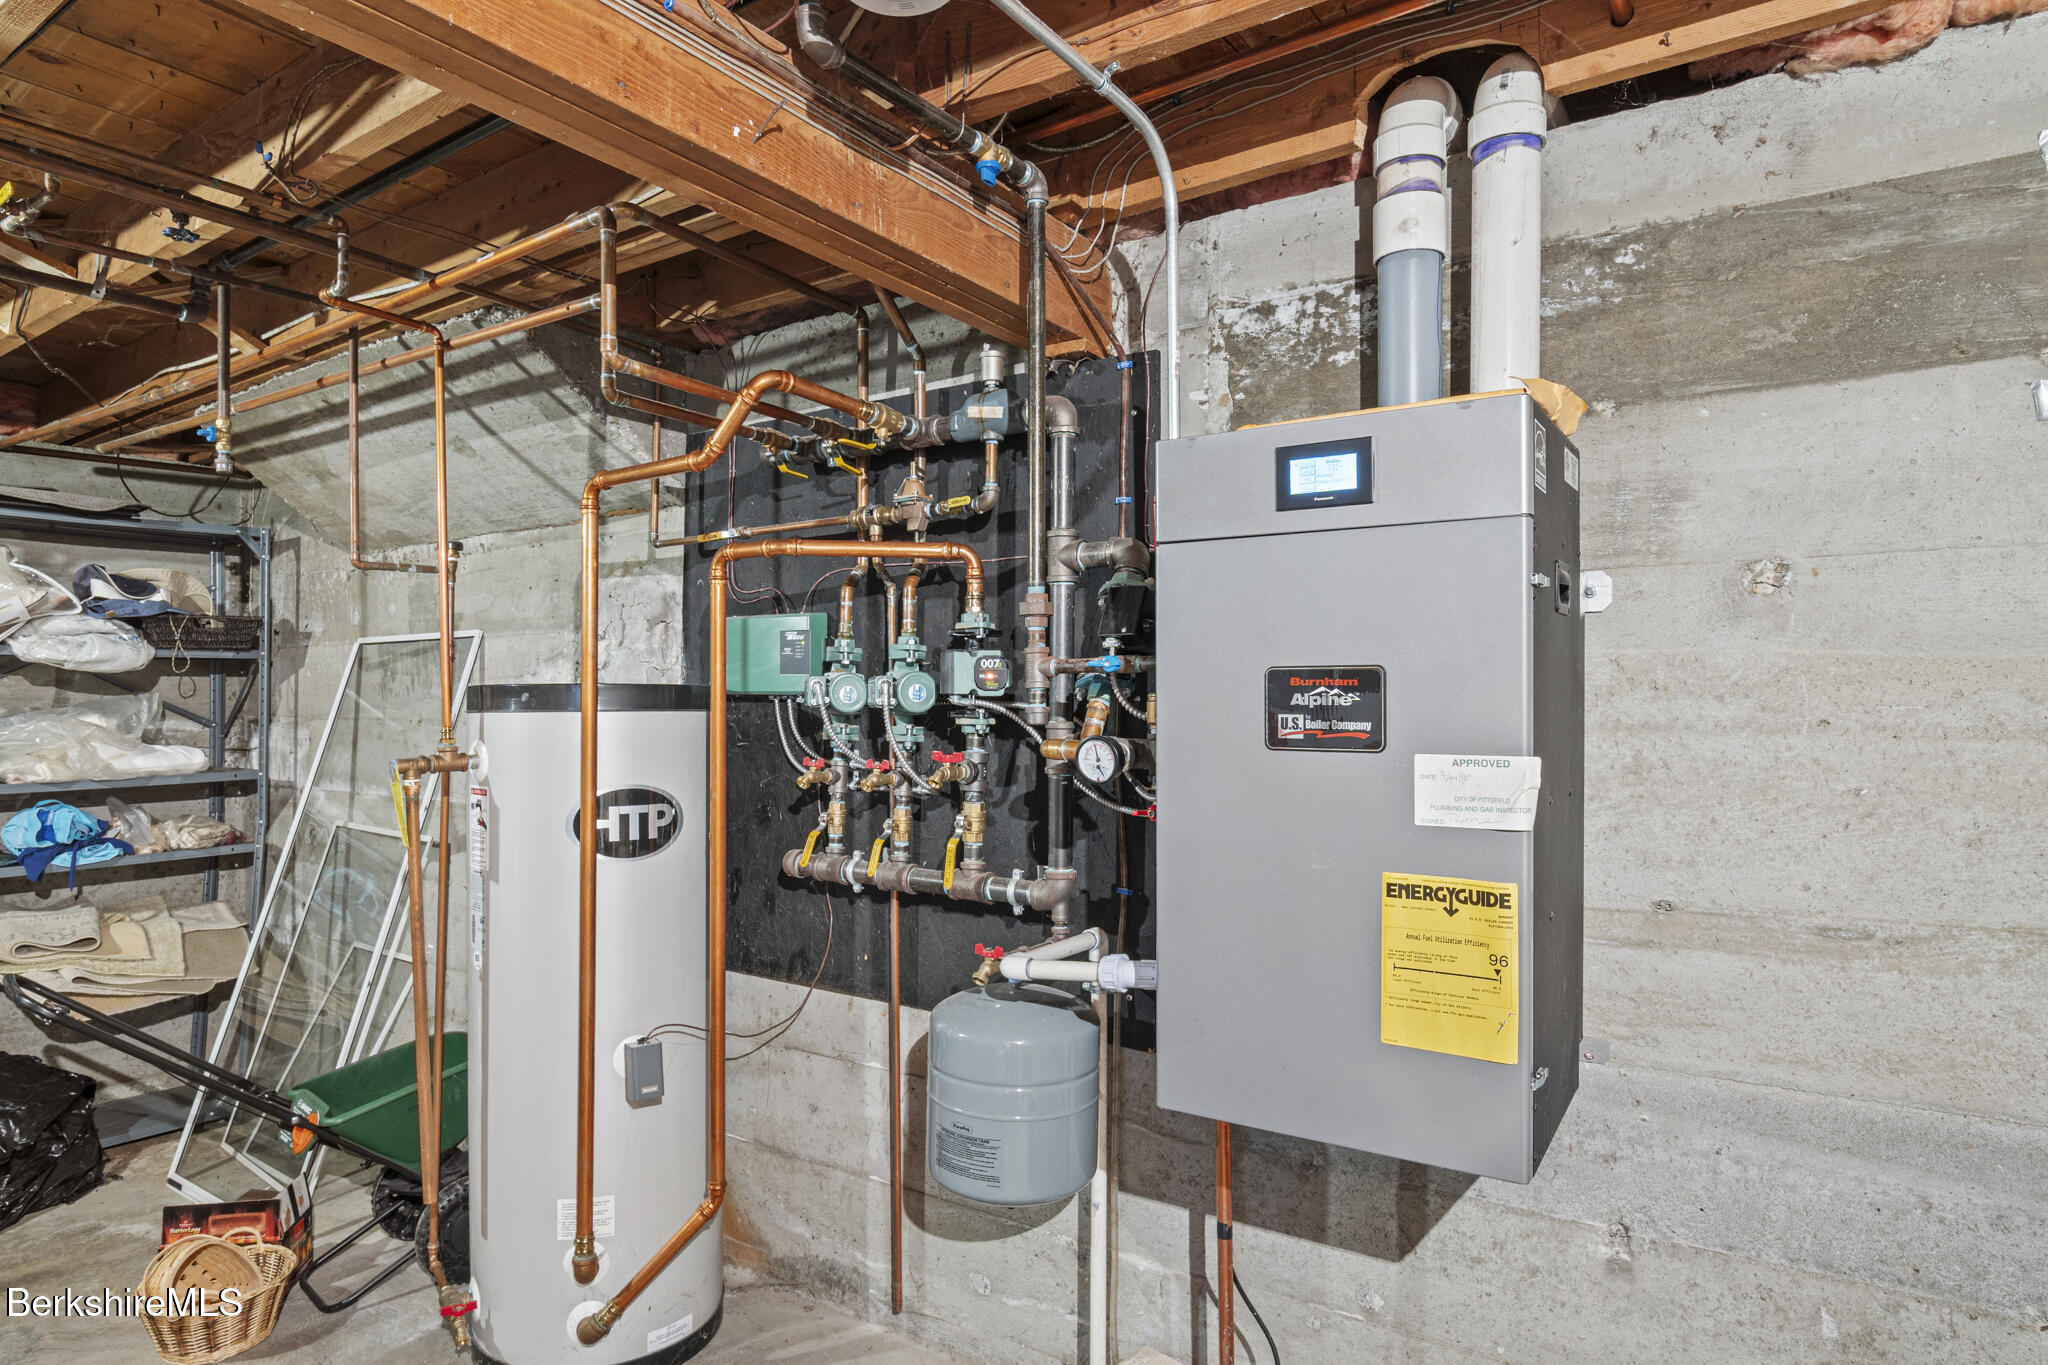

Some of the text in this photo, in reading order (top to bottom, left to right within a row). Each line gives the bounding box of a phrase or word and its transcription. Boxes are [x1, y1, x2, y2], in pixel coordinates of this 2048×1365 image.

[1289, 677, 1358, 686] Burnham
[1290, 693, 1353, 708] Alpine
[1280, 717, 1372, 731] U.S. Boiler Company
[1452, 759, 1511, 768] APPROVED
[1496, 806, 1532, 814] INSPECTOR
[1386, 882, 1511, 910] ENERGYGUIDE
[1422, 934, 1433, 942] Fuel
[1435, 936, 1463, 945] Utilization
[1464, 939, 1490, 949] Efficiency
[1489, 954, 1509, 967] 96
